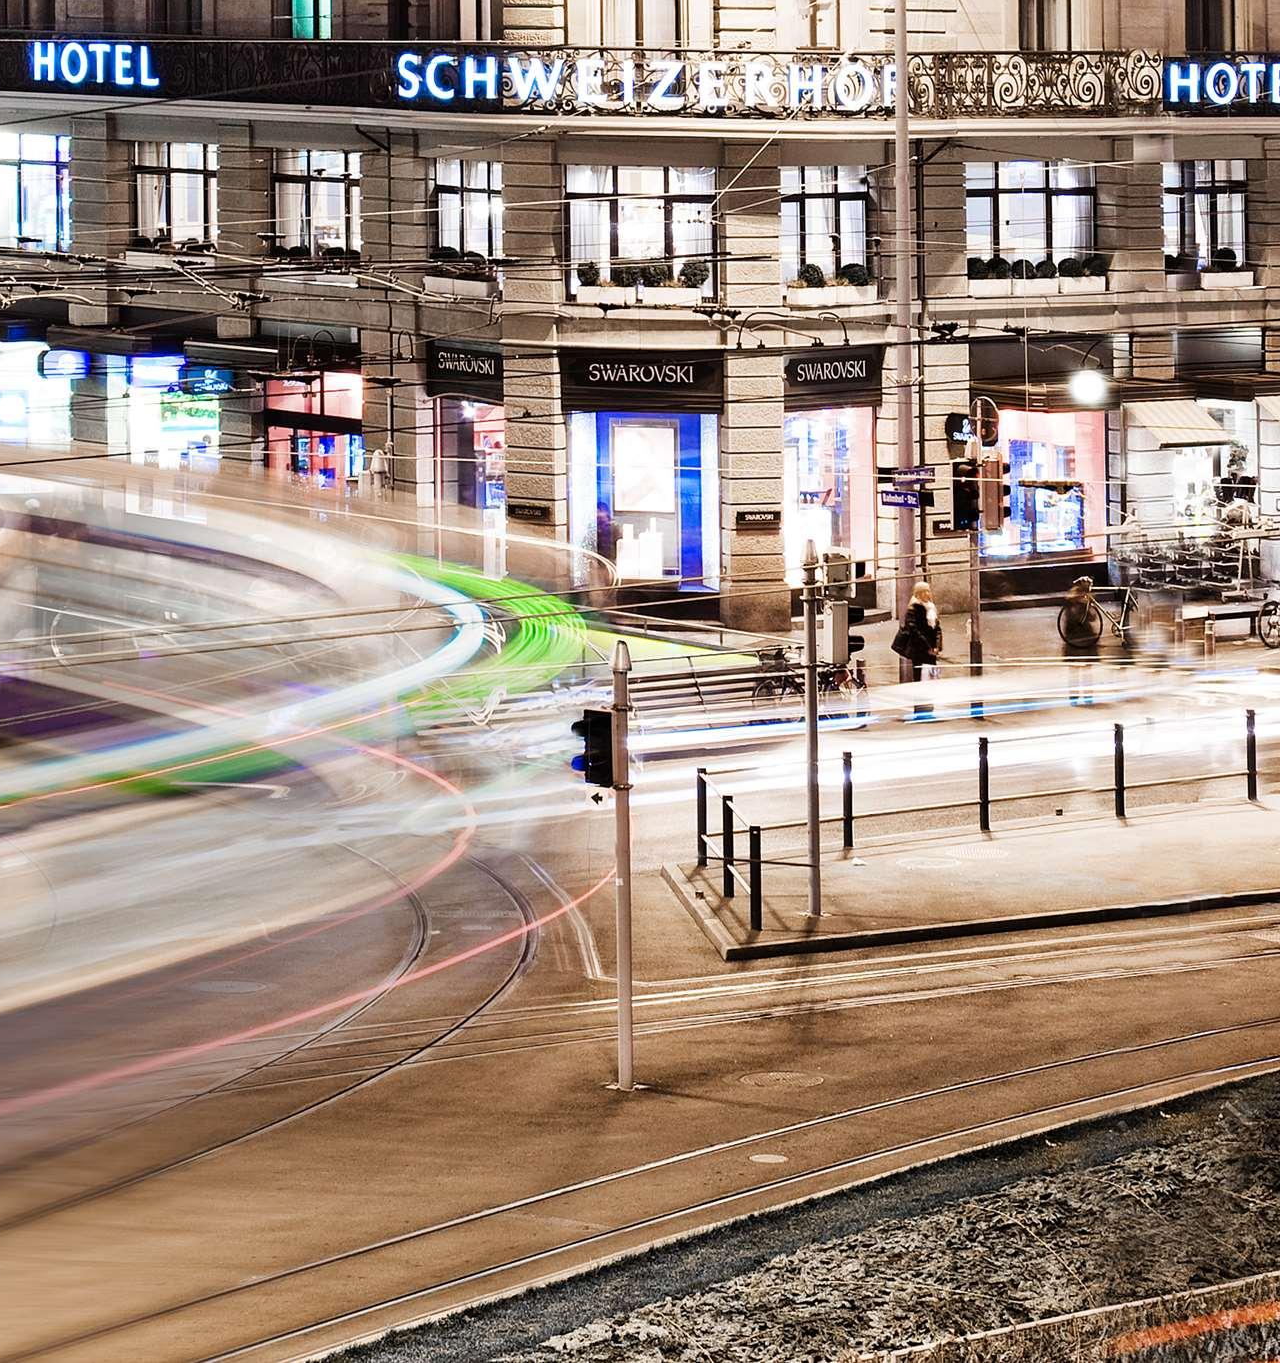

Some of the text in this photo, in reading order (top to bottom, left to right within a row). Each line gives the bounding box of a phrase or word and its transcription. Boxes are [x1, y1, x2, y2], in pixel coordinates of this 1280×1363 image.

[32, 42, 159, 86] HOTEL
[396, 51, 897, 111] SCHWEIZERHOF
[438, 351, 495, 375] SWAROVSKI
[588, 363, 694, 384] SWAROVSKI
[797, 360, 866, 382] SWAROVSKI
